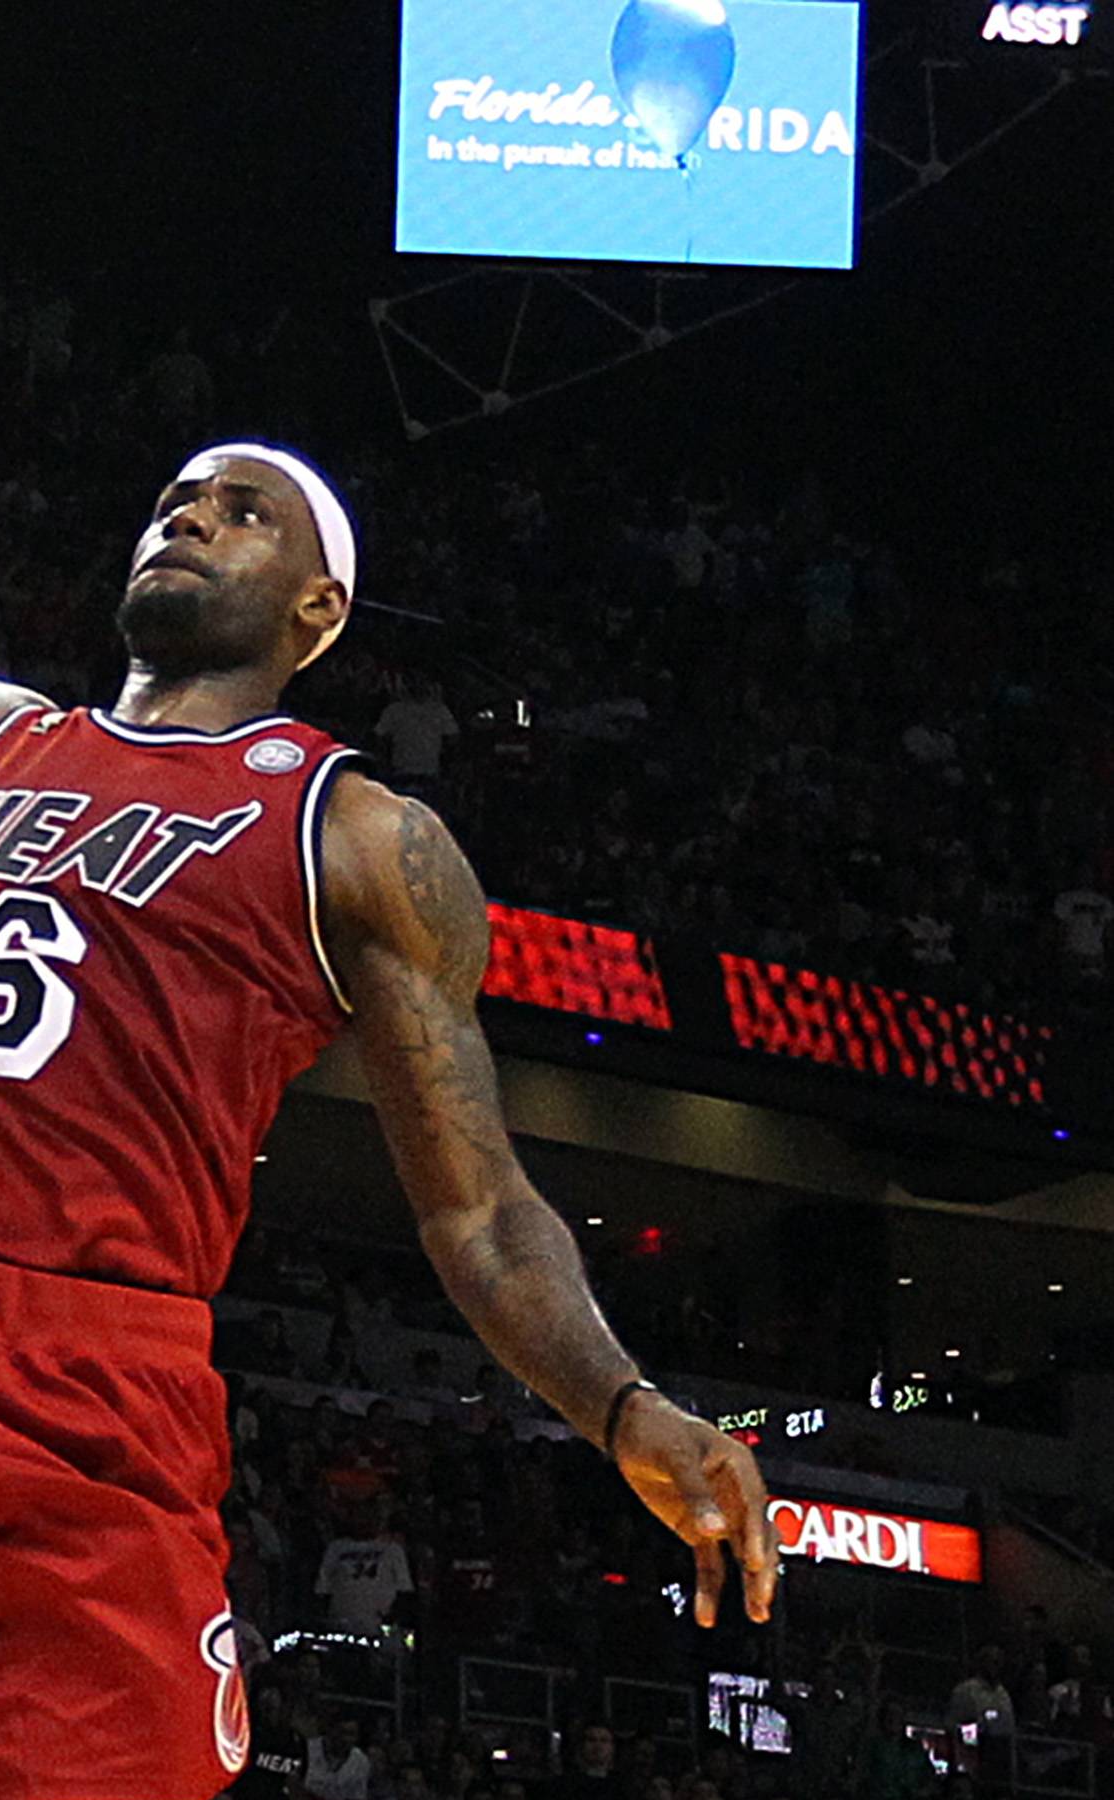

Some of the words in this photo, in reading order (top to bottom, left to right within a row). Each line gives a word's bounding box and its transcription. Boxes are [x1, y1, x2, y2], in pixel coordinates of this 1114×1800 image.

[982, 3, 1088, 45] ASST
[428, 75, 619, 127] Florida
[427, 134, 453, 161] In
[455, 135, 500, 162] the
[503, 143, 591, 171] pursuit
[593, 140, 624, 168] of
[707, 106, 854, 155] RIDA
